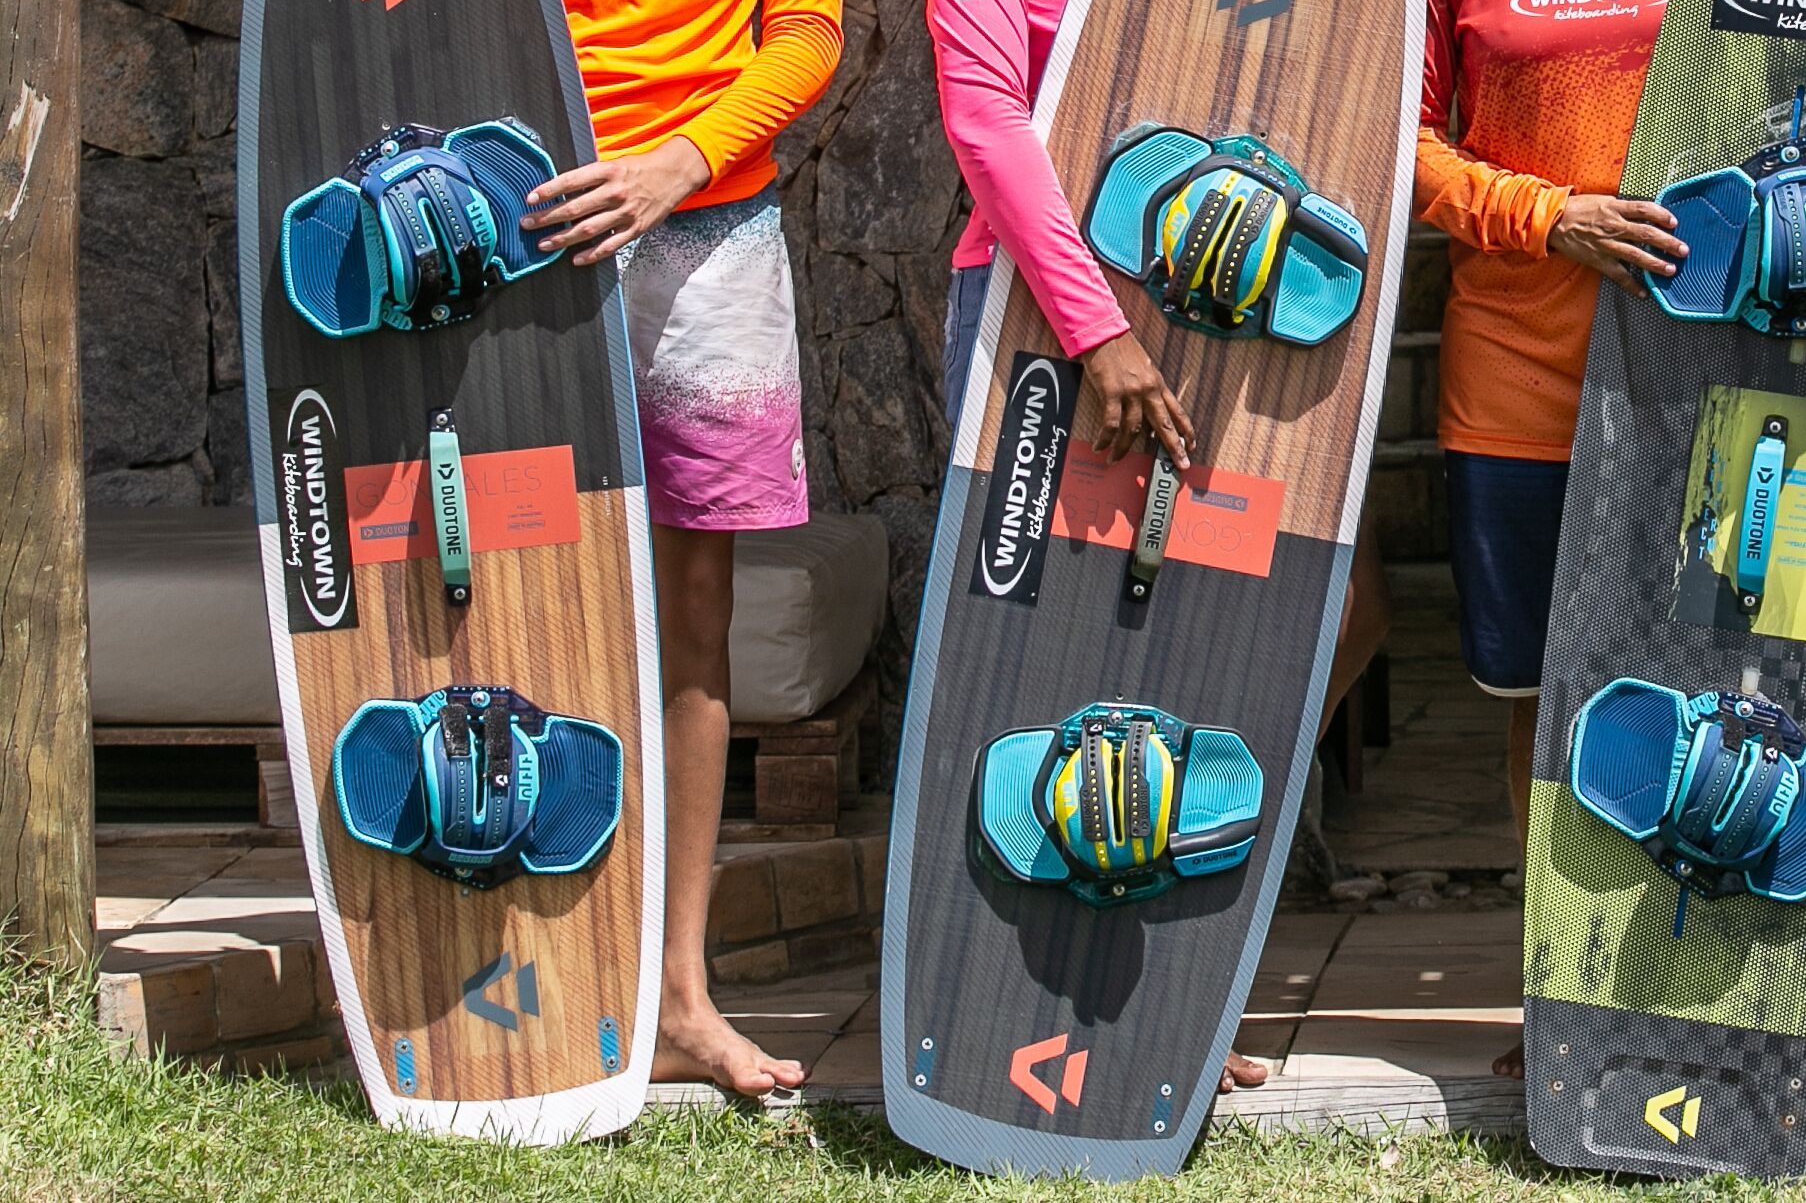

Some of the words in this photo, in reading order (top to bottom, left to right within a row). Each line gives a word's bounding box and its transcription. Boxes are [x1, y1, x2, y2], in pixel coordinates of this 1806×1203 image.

[1316, 206, 1349, 230] DUOTONE
[301, 414, 336, 599] WINDTOWN
[355, 465, 544, 508] GONALES
[994, 386, 1048, 567] WINDTOWN
[375, 524, 416, 536] DUOTON
[440, 485, 461, 556] DUOTONE
[1145, 479, 1172, 550] DUOTONE
[1746, 489, 1770, 560] DUOTONE
